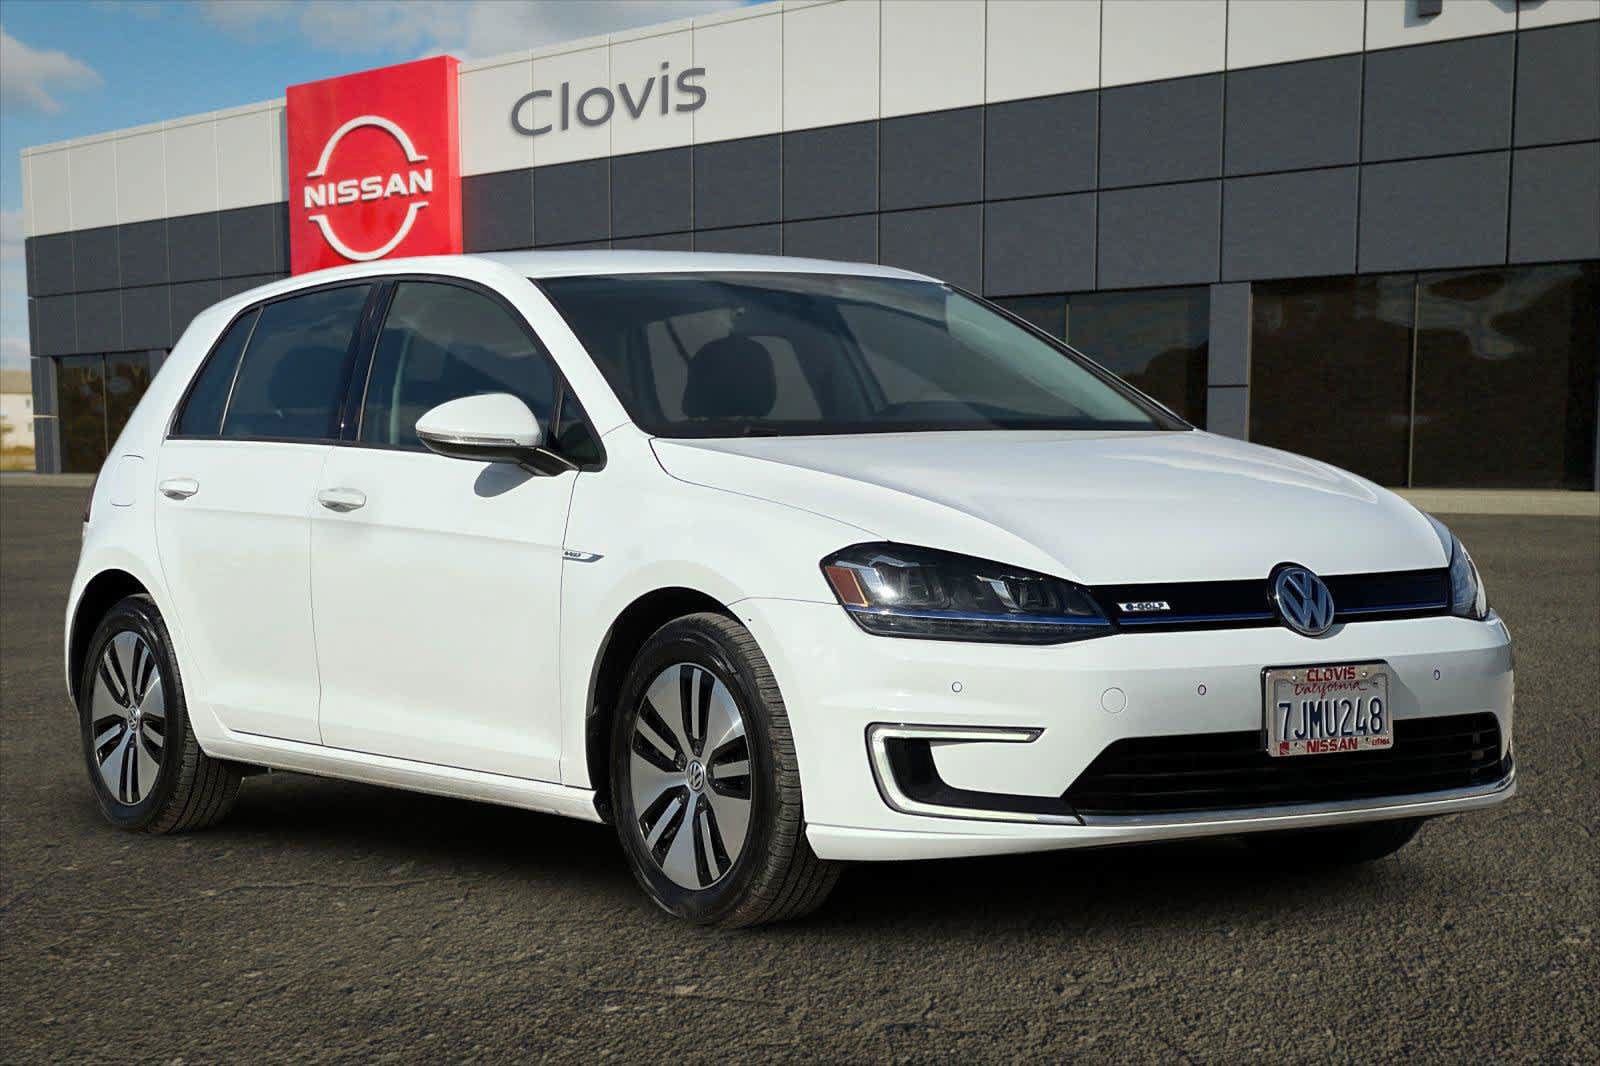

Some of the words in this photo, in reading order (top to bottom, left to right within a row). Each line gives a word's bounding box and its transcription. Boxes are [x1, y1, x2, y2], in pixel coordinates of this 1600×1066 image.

[511, 62, 707, 136] Clovis
[303, 168, 434, 209] NISSAN
[1306, 666, 1356, 682] CLOVIS
[1278, 696, 1383, 741] 7JMU248
[1306, 737, 1358, 753] NISSAN
